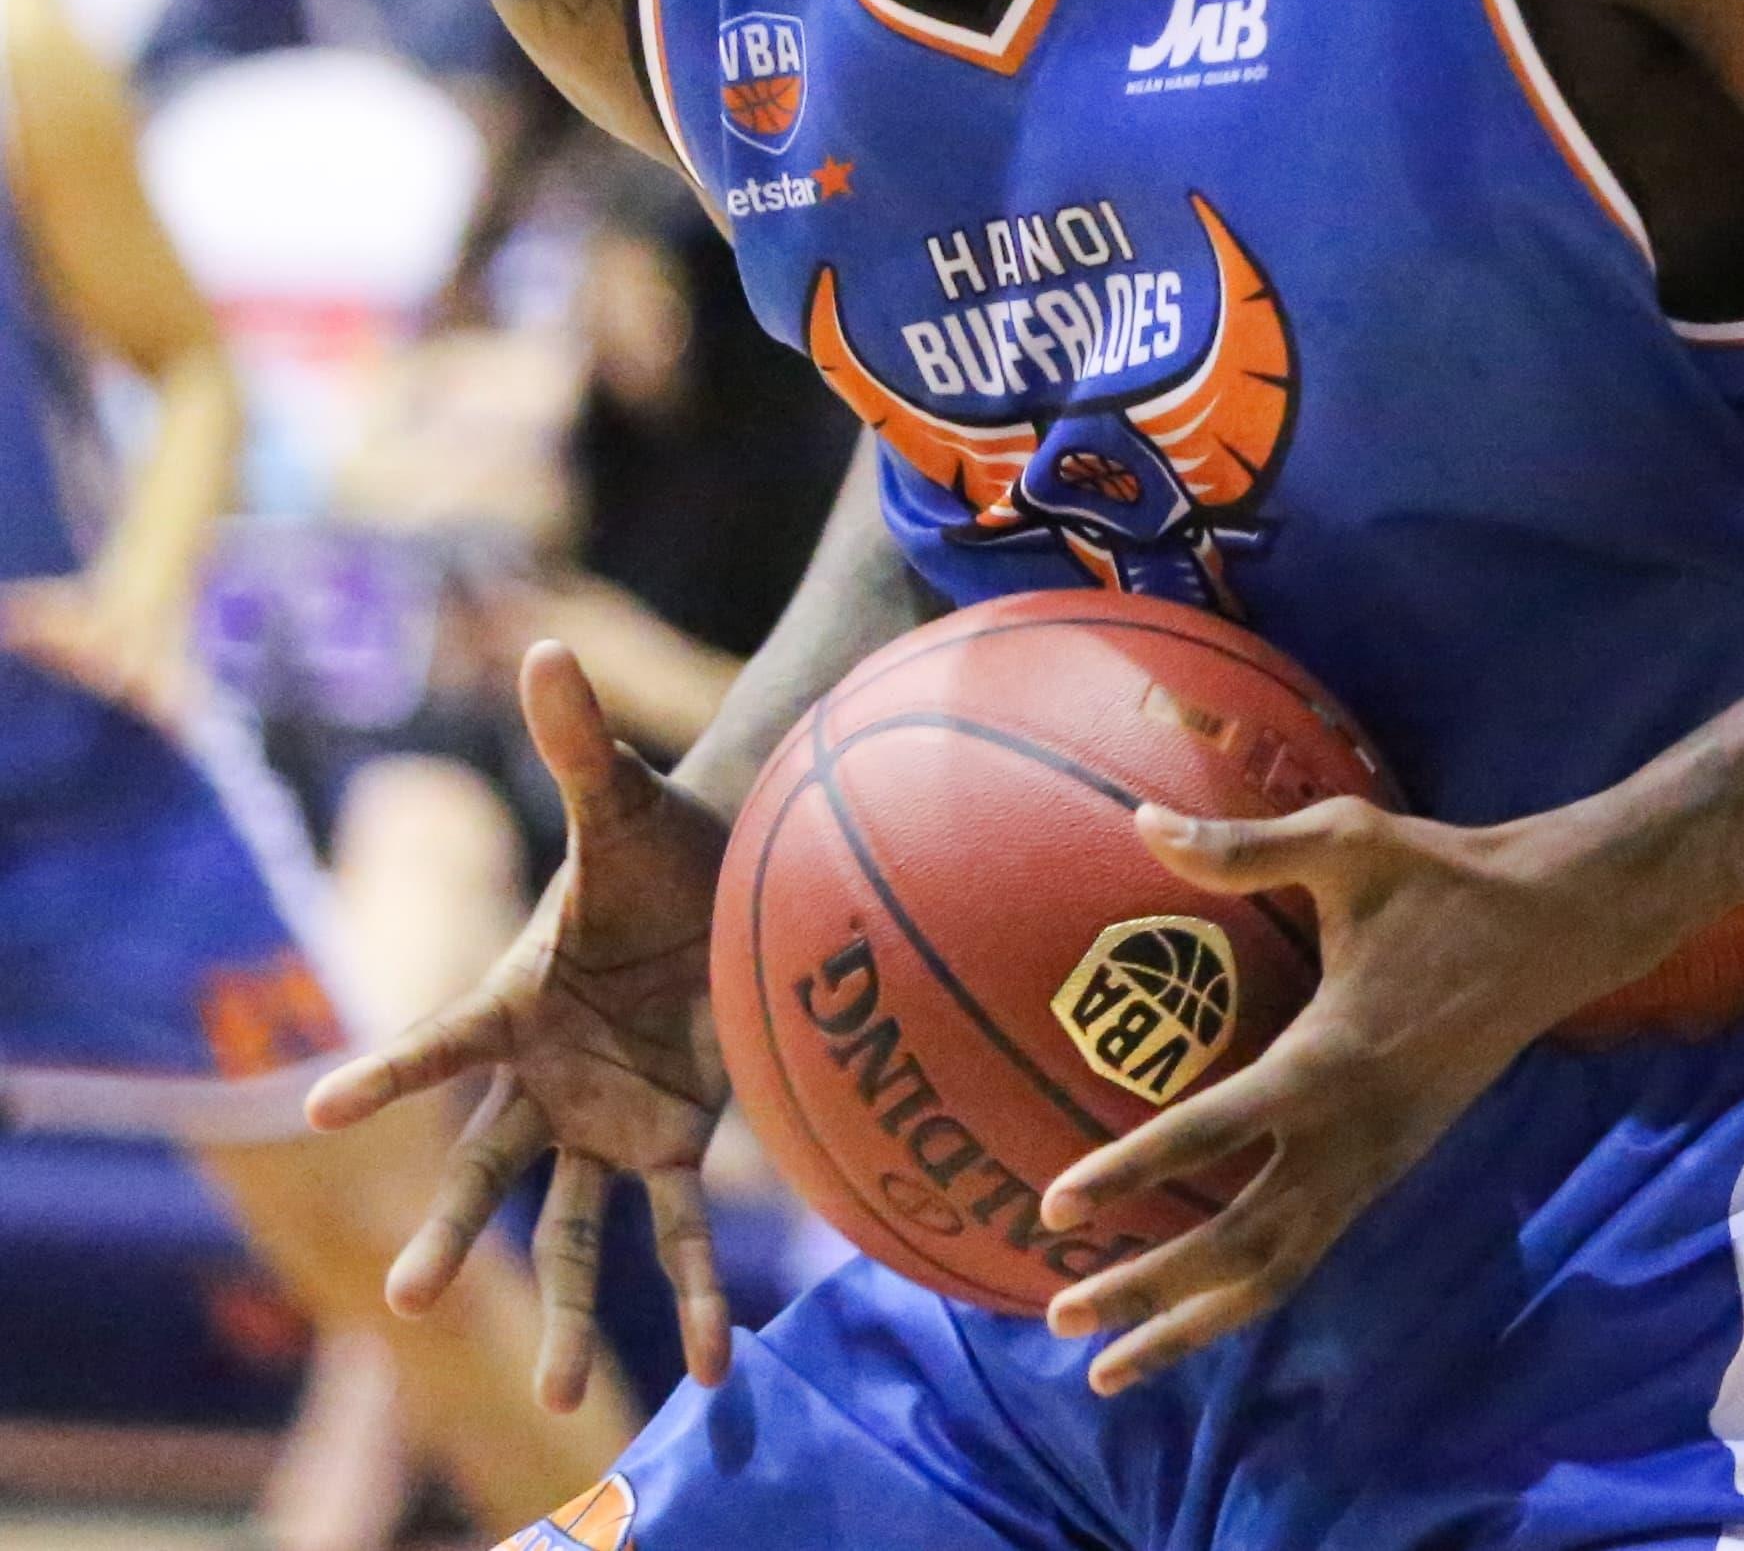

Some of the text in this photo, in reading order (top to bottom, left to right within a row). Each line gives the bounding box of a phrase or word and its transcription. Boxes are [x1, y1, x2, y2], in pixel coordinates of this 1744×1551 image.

[719, 23, 800, 81] VBA
[727, 172, 818, 217] etstar
[927, 201, 1133, 299] HANOI
[901, 271, 1182, 396] BUFFALOES
[1072, 963, 1190, 1095] VBA
[795, 938, 1156, 1281] PALDING
